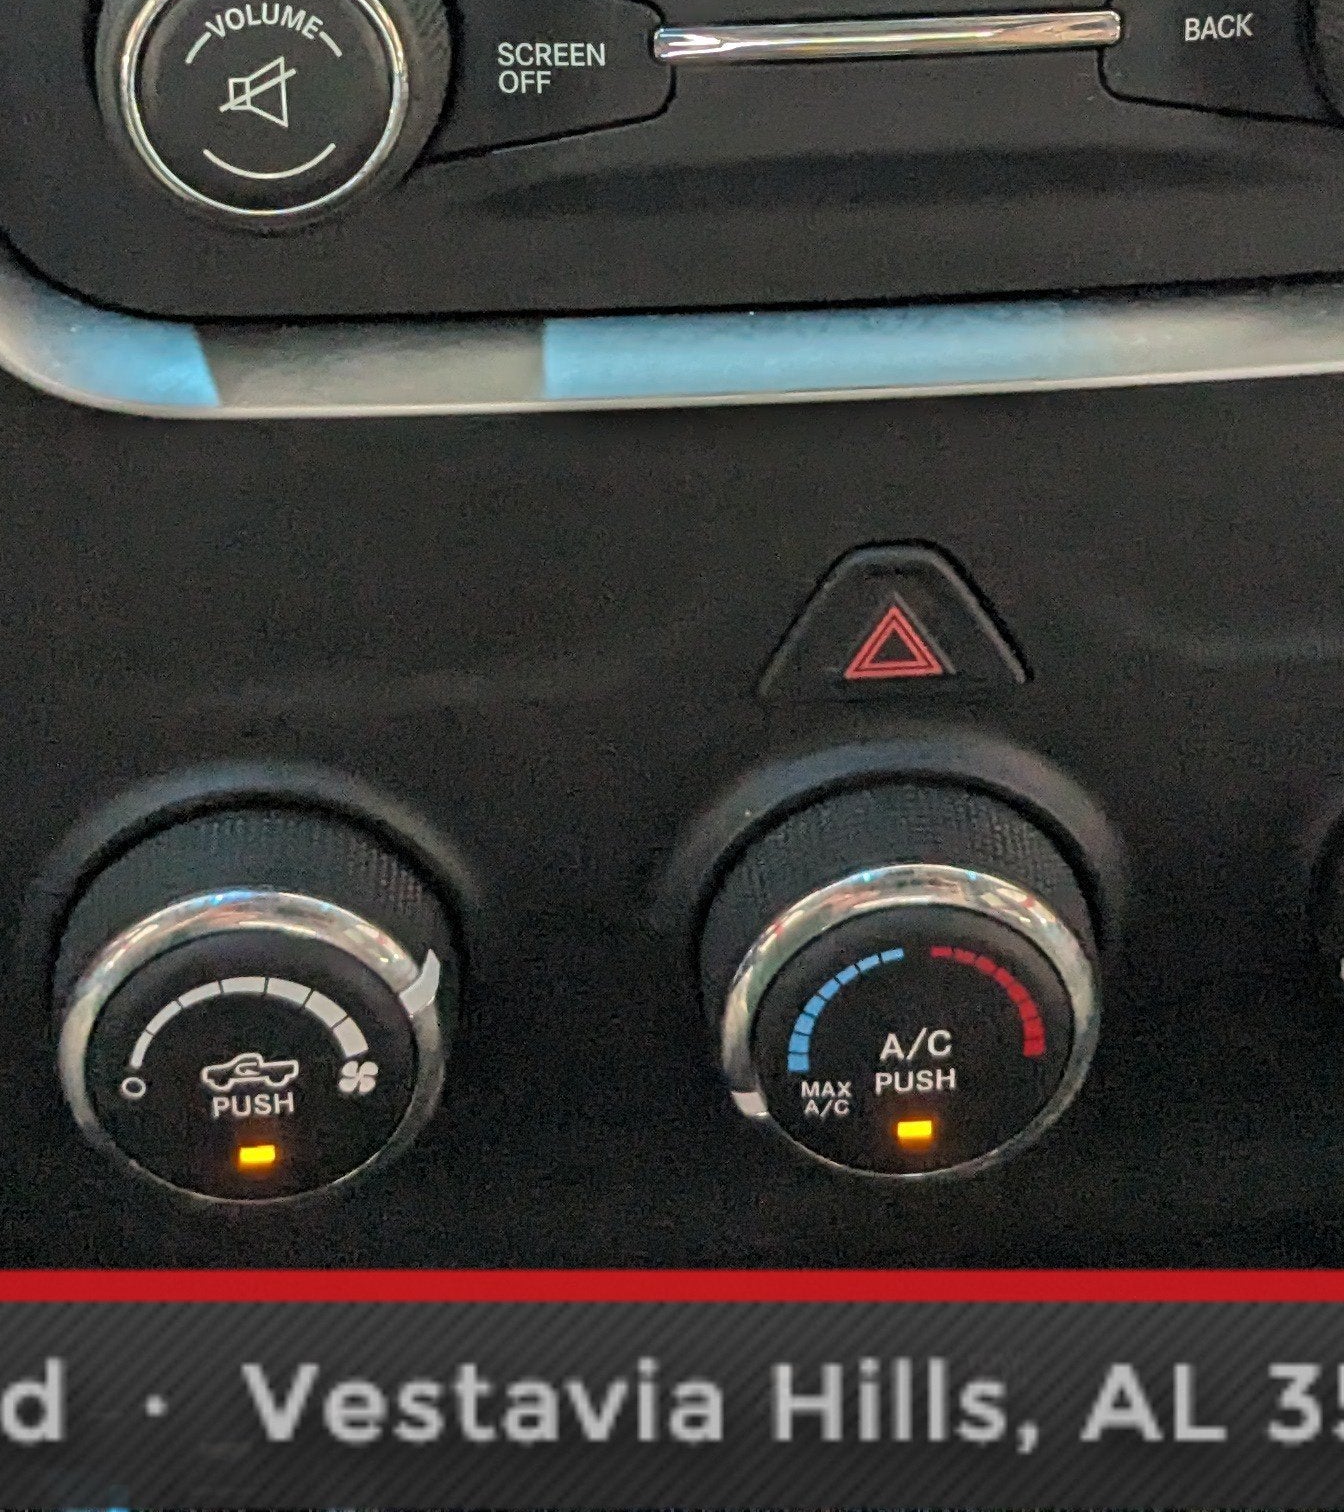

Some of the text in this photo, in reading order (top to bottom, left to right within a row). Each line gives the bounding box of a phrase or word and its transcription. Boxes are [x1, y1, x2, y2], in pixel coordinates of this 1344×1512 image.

[204, 1, 326, 40] VOLUME
[1183, 11, 1255, 43] BACK
[496, 41, 607, 68] SCREEN
[497, 69, 553, 95] OFF
[879, 1026, 953, 1062] A/C
[800, 1080, 853, 1100] MAX
[874, 1066, 957, 1096] PUSH
[212, 1089, 296, 1119] PUSH
[802, 1099, 851, 1119] A/C
